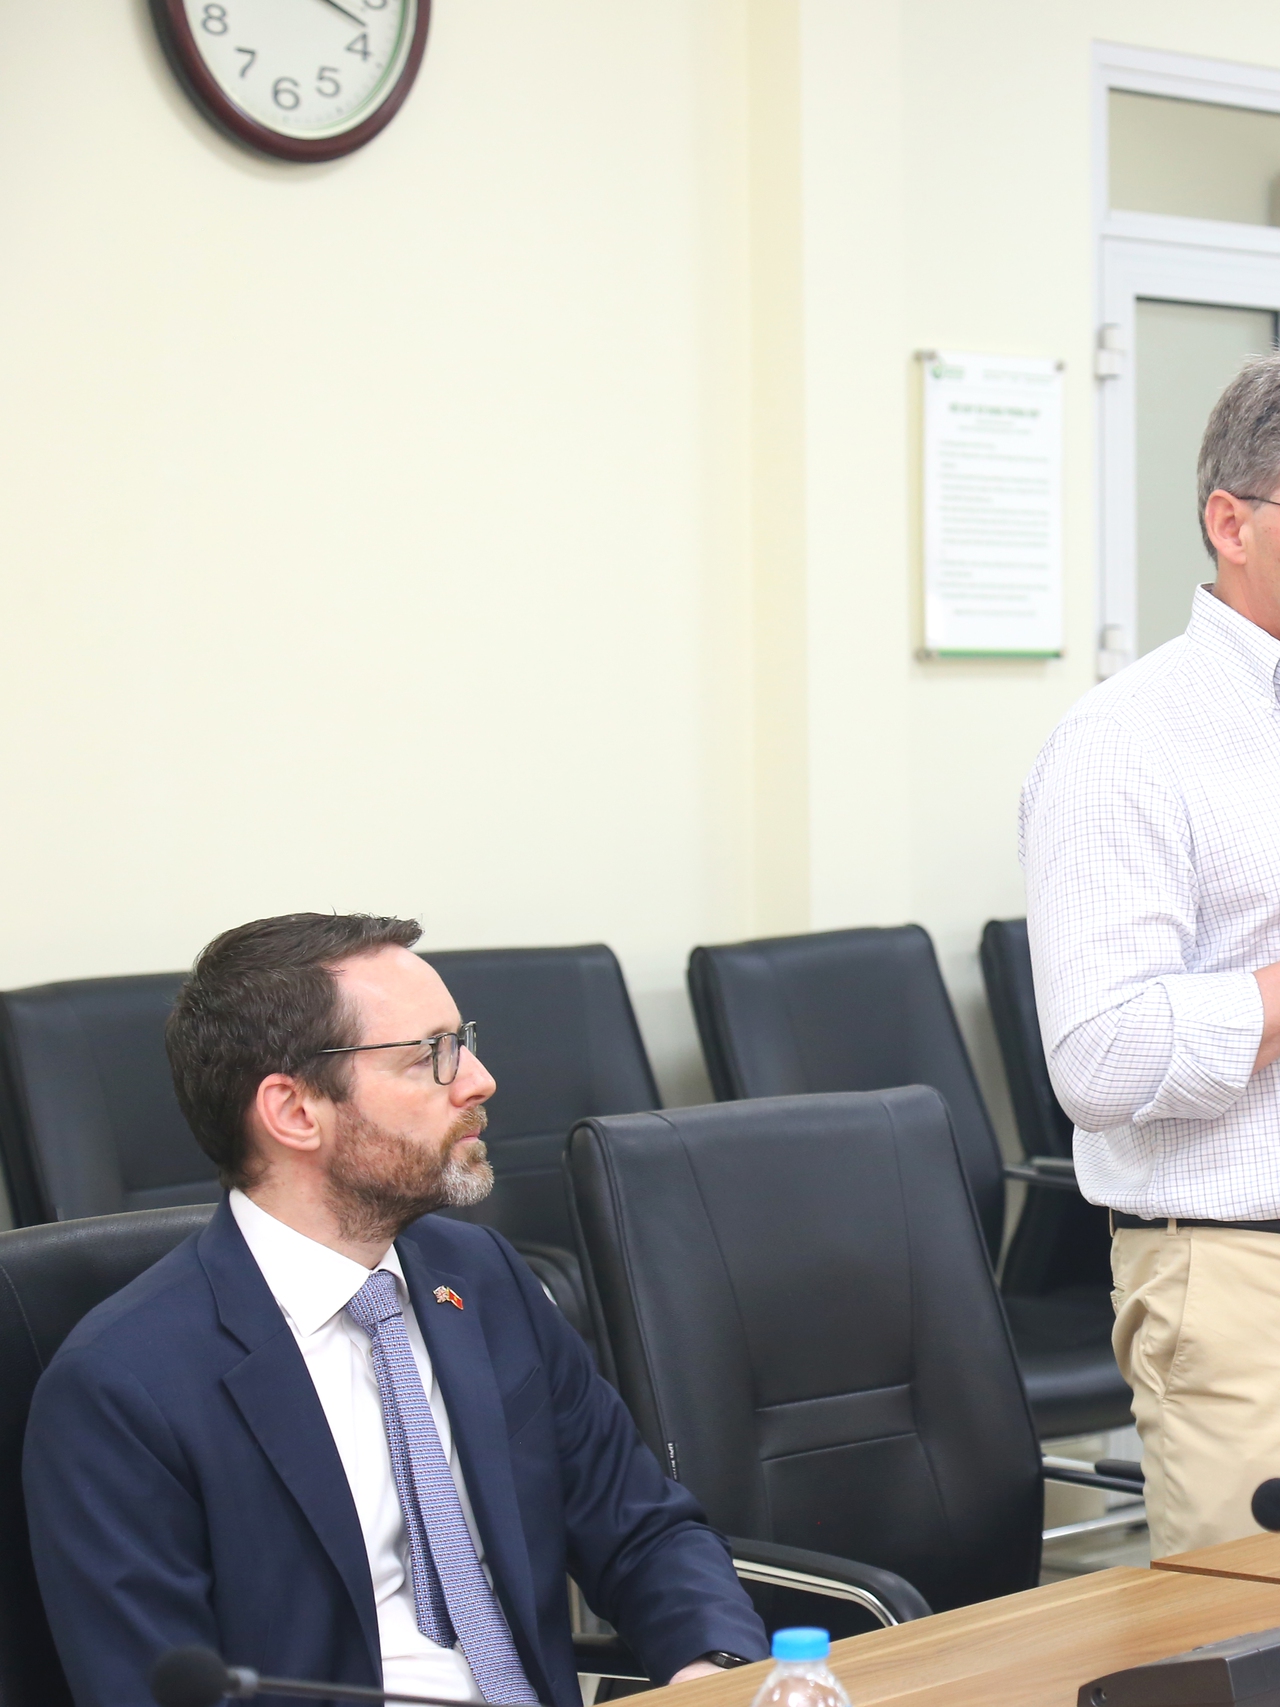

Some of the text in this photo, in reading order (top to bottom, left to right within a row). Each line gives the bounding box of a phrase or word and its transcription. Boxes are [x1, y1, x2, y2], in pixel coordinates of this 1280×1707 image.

[201, 3, 229, 36] 8
[345, 32, 371, 61] 4
[235, 47, 257, 79] 7
[271, 77, 300, 111] 6
[315, 66, 341, 98] 5
